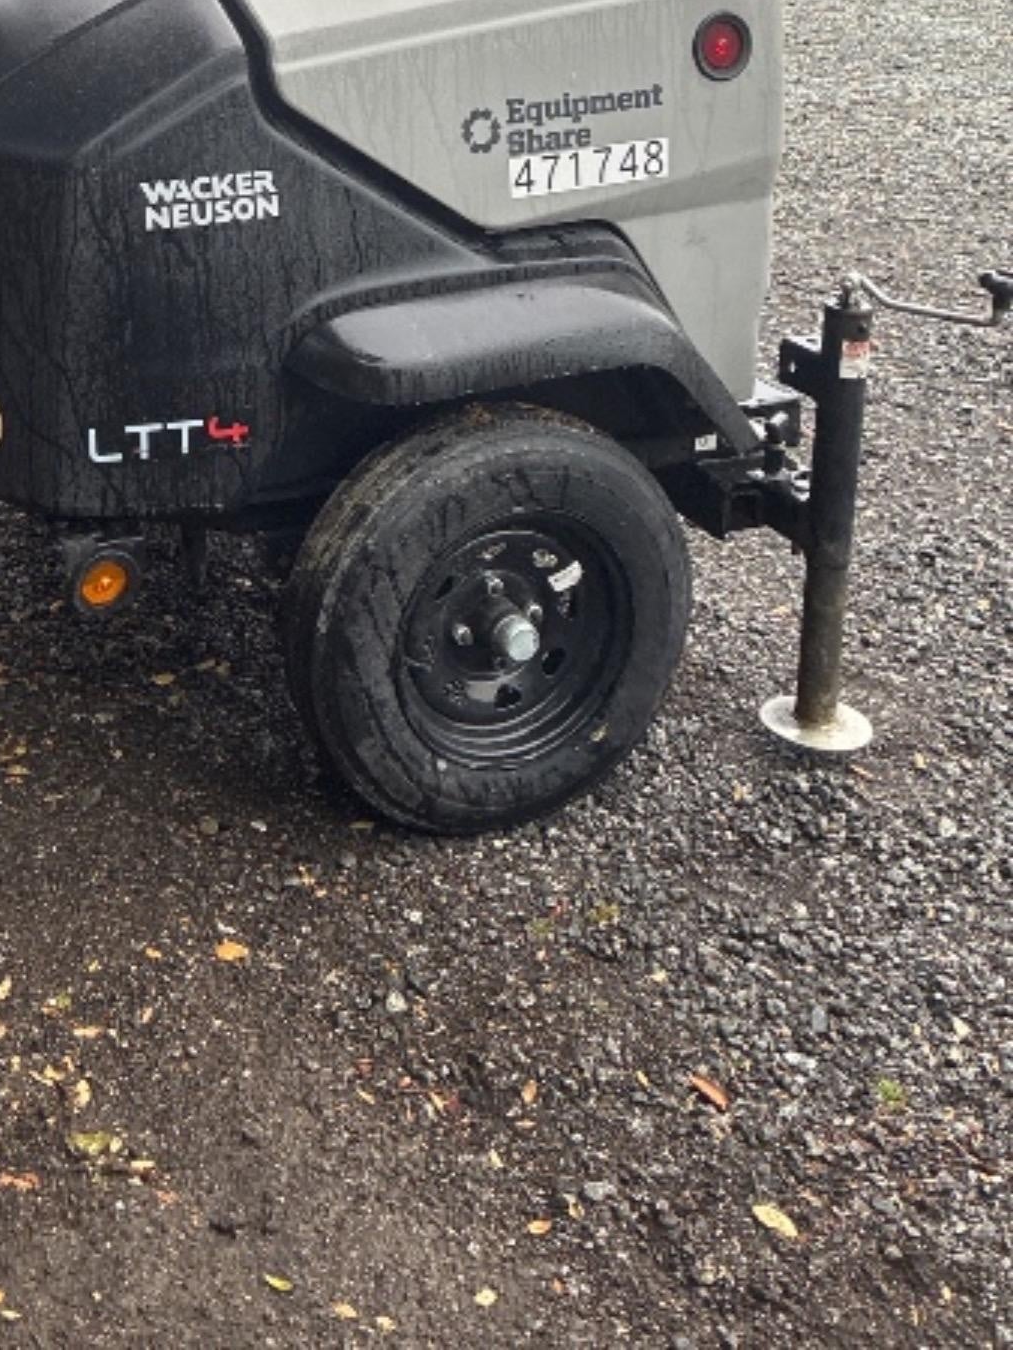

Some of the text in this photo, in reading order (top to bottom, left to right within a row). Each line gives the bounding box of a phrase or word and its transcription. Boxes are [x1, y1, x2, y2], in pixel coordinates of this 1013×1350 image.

[506, 83, 664, 126] Equipment
[506, 127, 592, 157] Share
[514, 139, 664, 193] 471748
[139, 170, 279, 205] WACKER
[144, 193, 281, 232] NEUSON
[88, 415, 250, 464] LTT4
